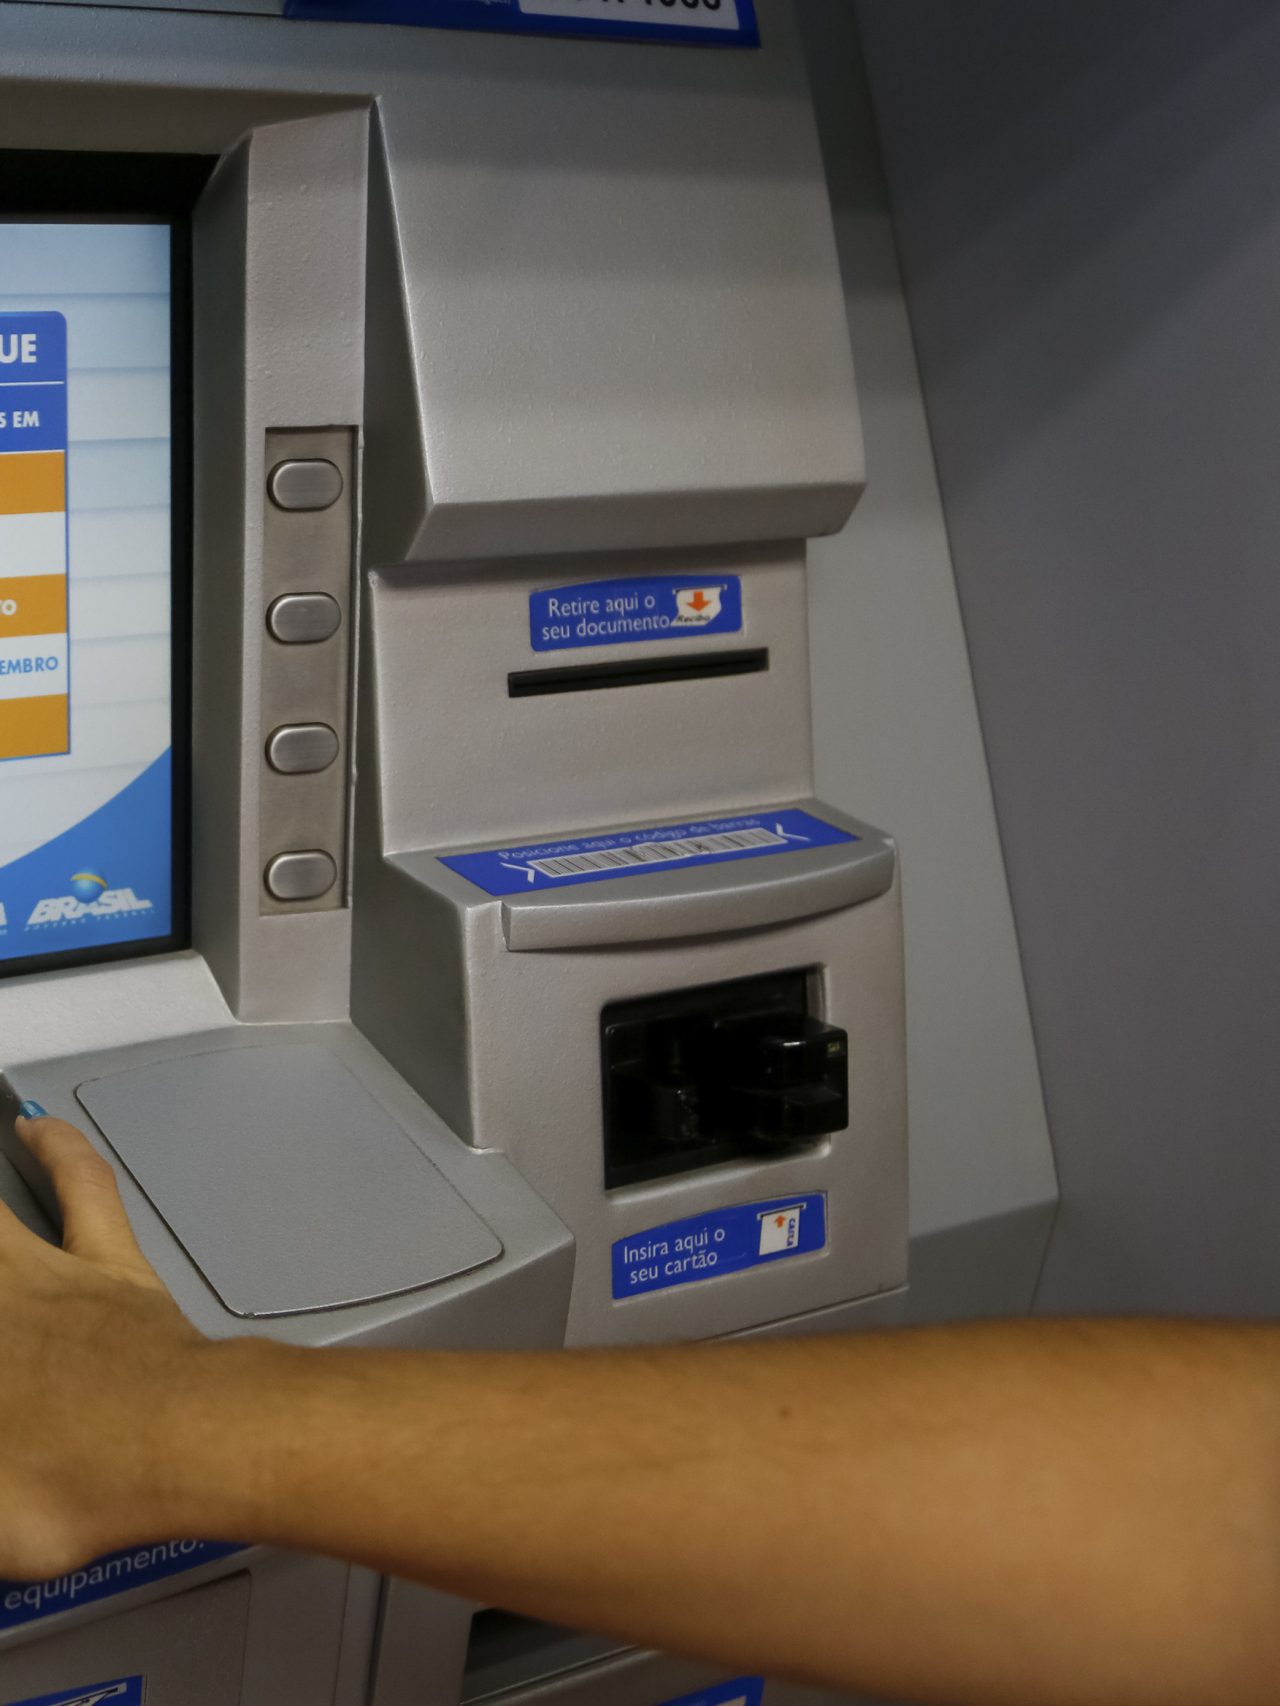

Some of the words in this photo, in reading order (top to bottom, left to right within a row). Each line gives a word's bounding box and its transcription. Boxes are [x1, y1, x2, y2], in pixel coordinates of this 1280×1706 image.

[12, 410, 40, 429] EM
[548, 598, 600, 617] Retire
[605, 592, 639, 614] aqui
[644, 595, 656, 609] o
[542, 624, 570, 640] seu
[576, 614, 670, 637] documento
[498, 843, 580, 860] Posicione
[27, 887, 153, 926] BRASIL
[623, 1240, 669, 1264] Insira
[674, 1227, 709, 1254] aqui
[714, 1228, 726, 1242] o
[630, 1266, 659, 1284] seu
[664, 1249, 718, 1276] cartão
[4, 1538, 205, 1610] equipamento.
